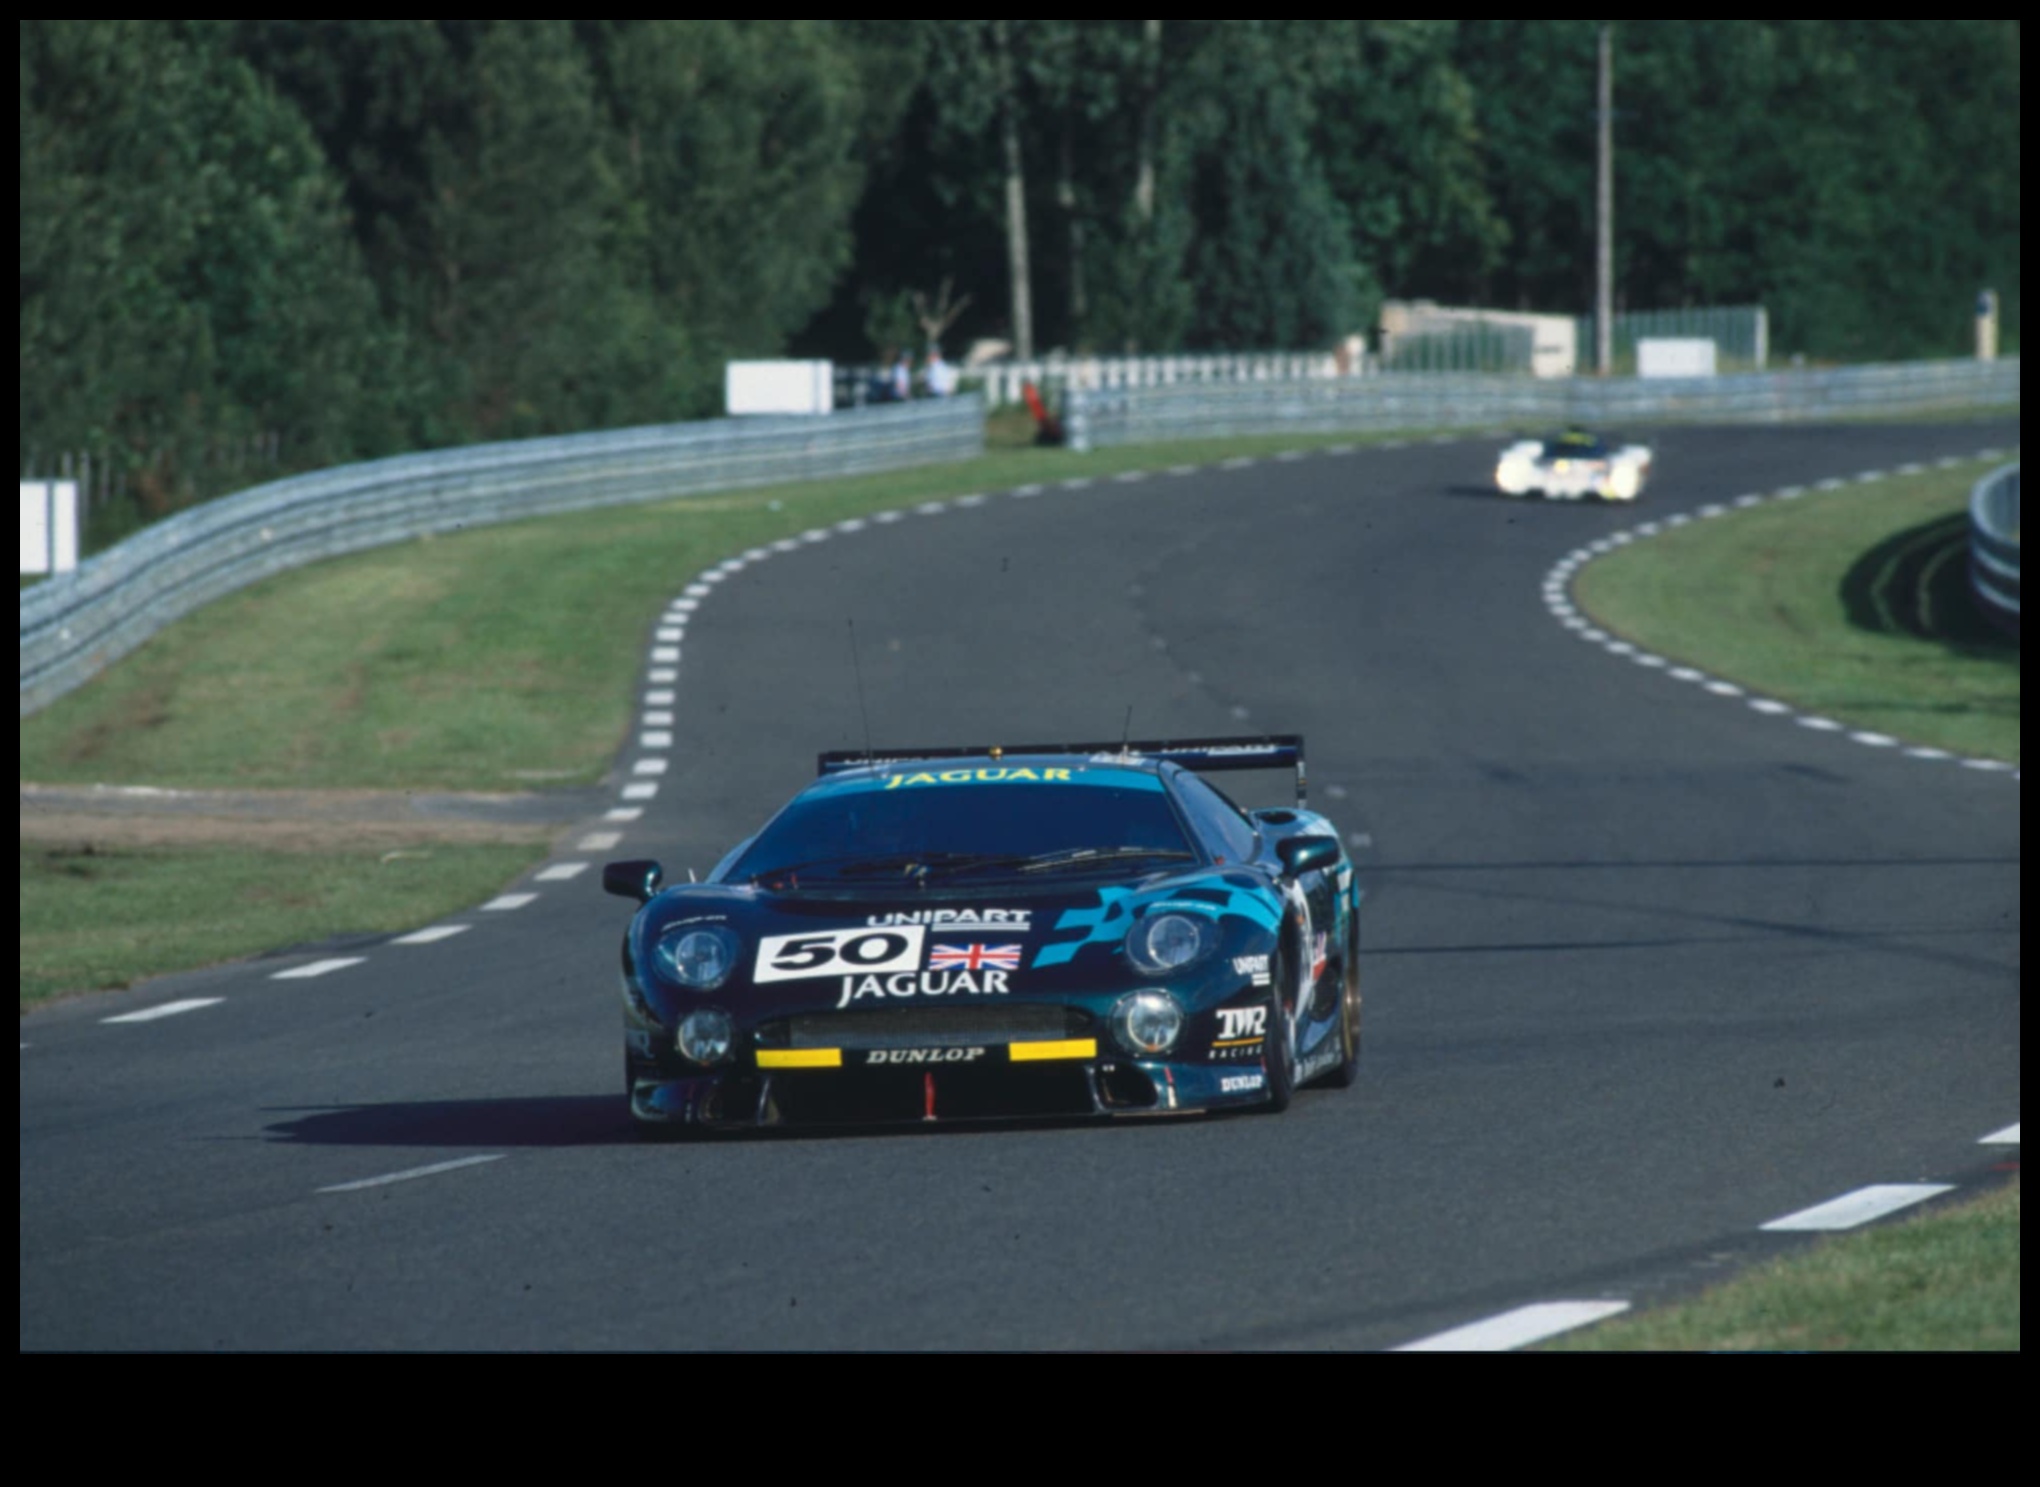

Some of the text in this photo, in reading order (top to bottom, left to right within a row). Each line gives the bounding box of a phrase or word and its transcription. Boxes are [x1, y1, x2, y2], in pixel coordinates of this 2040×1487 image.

[885, 767, 1071, 790] JAGUAR
[867, 908, 1032, 926] UNIPART
[770, 933, 909, 970] 50
[836, 970, 1010, 1008] JAGUAR
[1216, 1006, 1267, 1039] TWR
[866, 1047, 985, 1064] DUNLOP
[1221, 1074, 1263, 1092] DUNLOP
